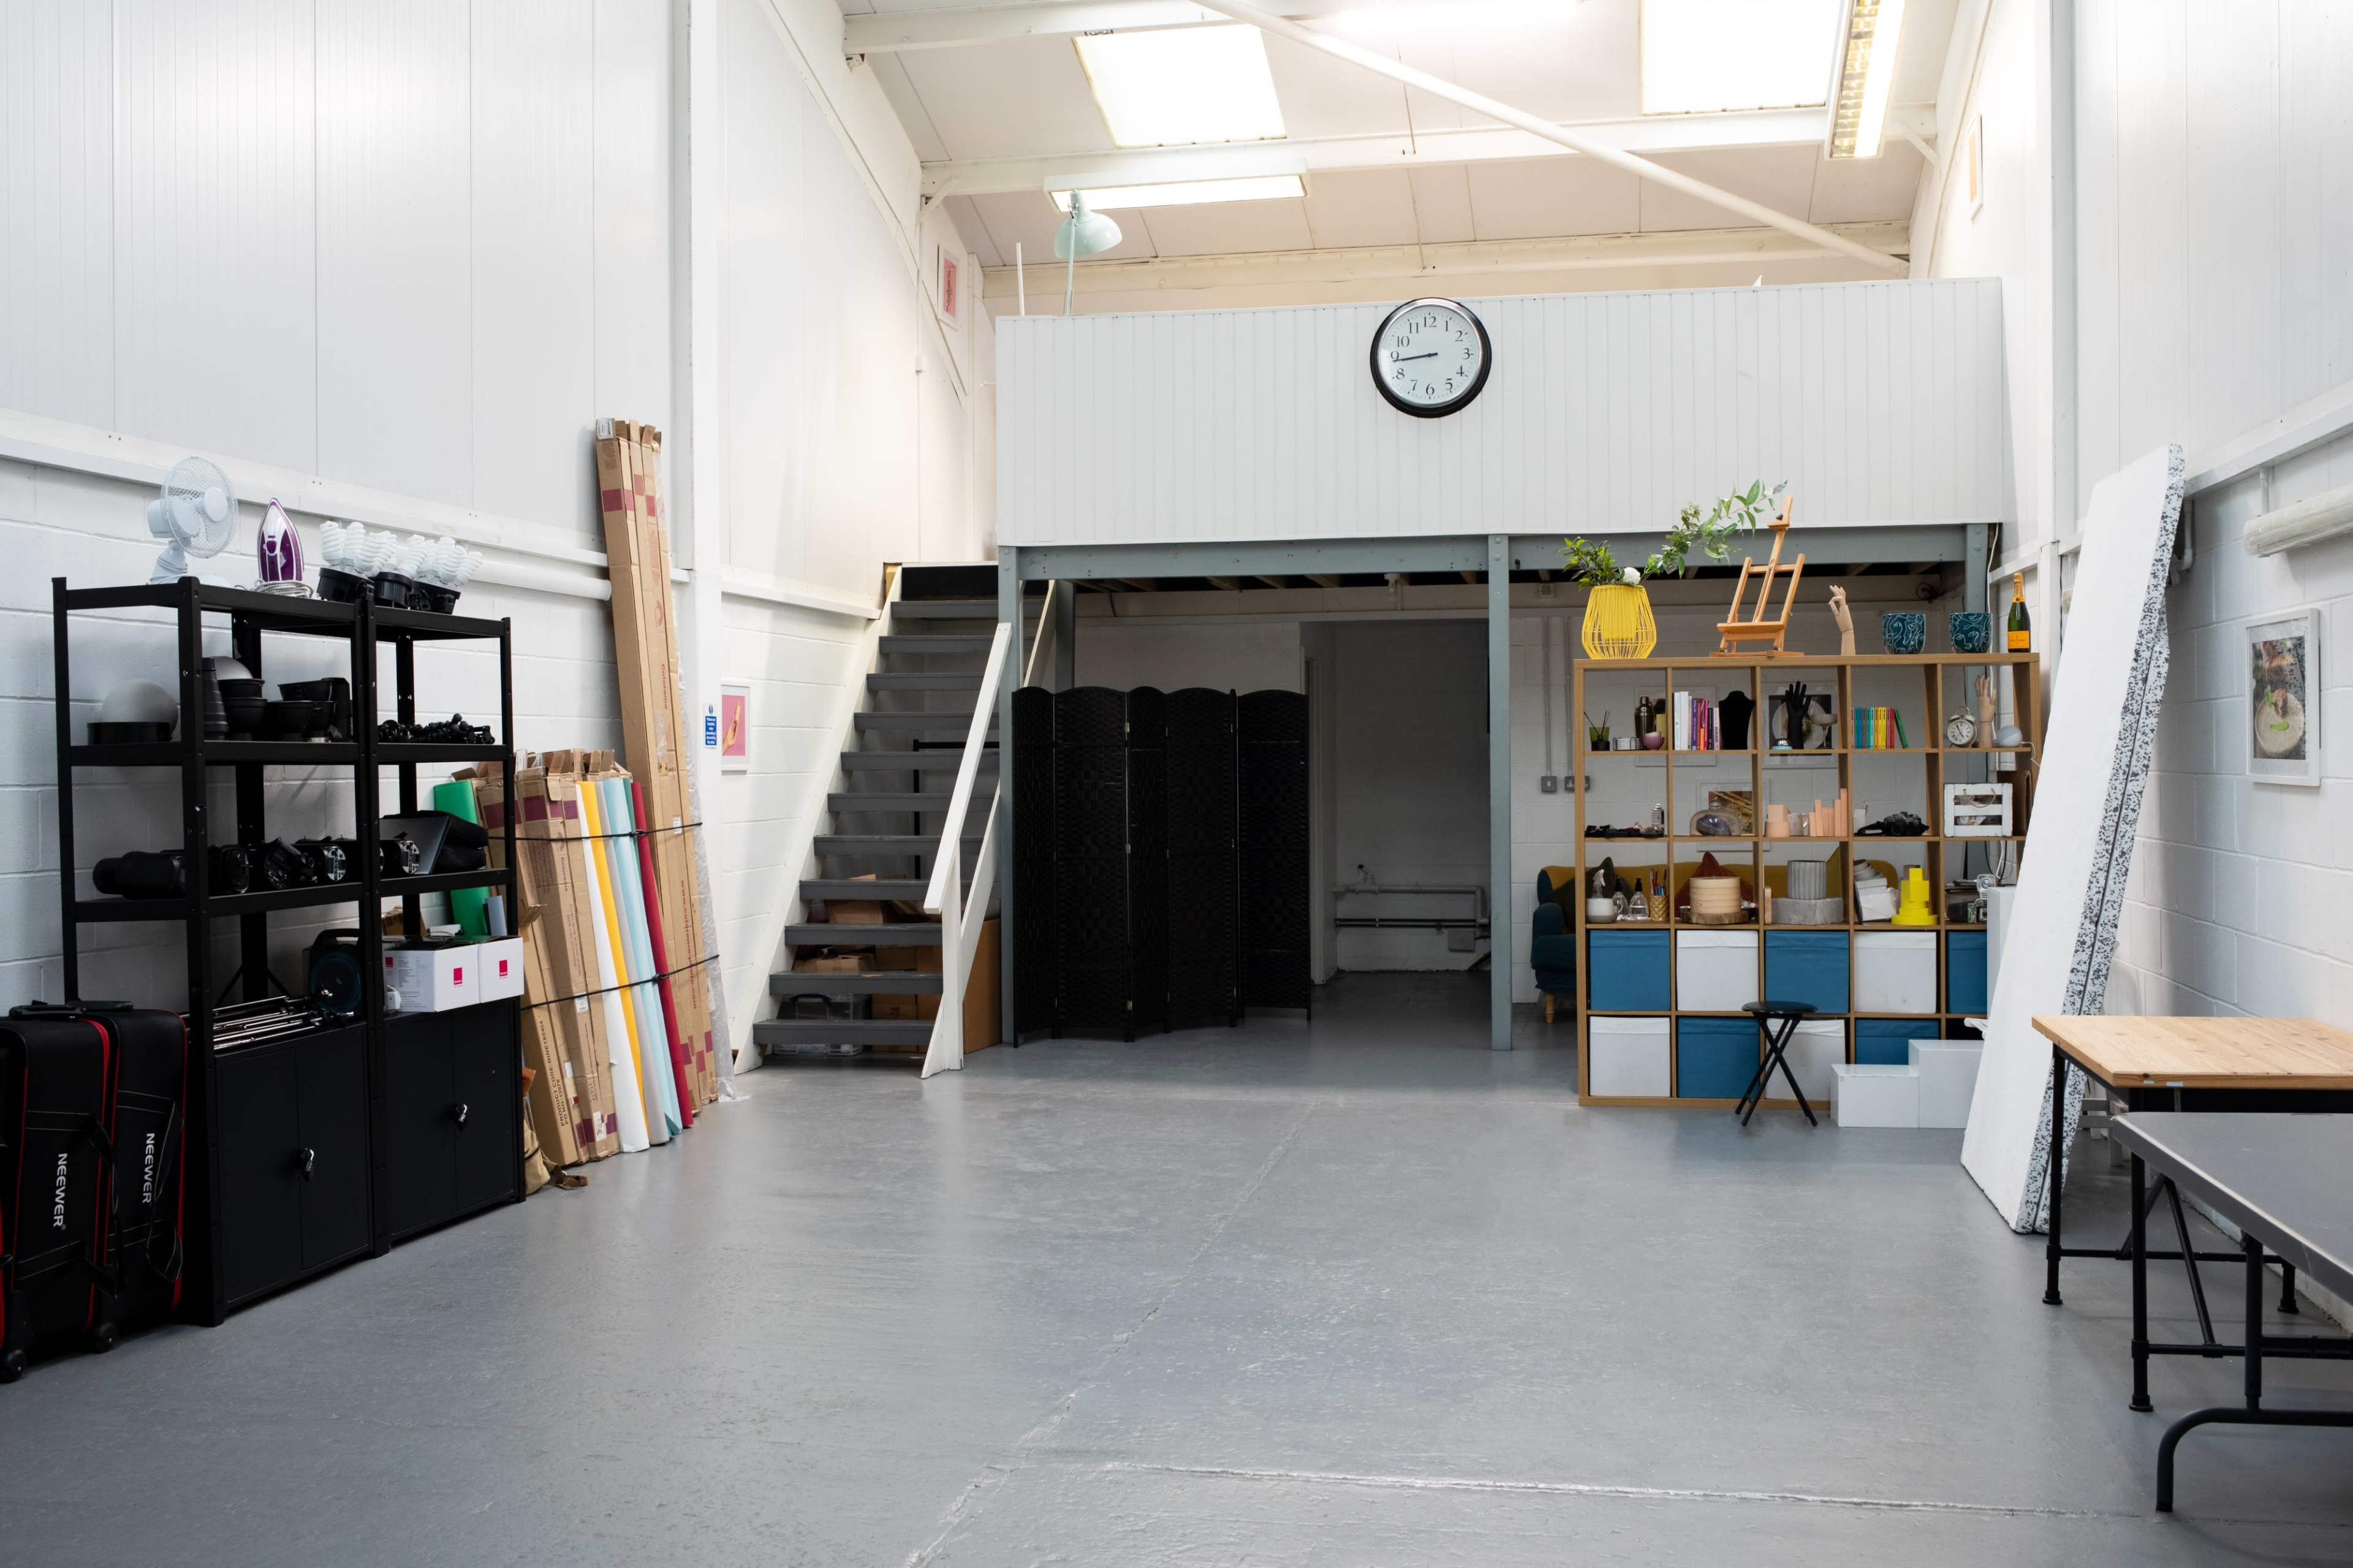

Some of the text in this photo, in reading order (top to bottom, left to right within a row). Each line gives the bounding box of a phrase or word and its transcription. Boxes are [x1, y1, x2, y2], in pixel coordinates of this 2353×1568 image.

[1409, 322, 1419, 333] 11
[1423, 316, 1437, 327] 12
[1445, 320, 1449, 331] 1
[1396, 335, 1410, 347] 10
[1455, 330, 1463, 342] 2
[1390, 350, 1400, 363] 9
[1463, 347, 1470, 360] 3
[1396, 368, 1405, 379] 8
[1456, 365, 1464, 377] 4
[1411, 379, 1418, 391] 7
[1425, 382, 1435, 395] 6
[1445, 378, 1453, 390] 5
[681, 880, 697, 1009] www.colorama-poto.com
[553, 1089, 565, 1127] PRODUCT
[142, 1133, 155, 1203] NEEWER
